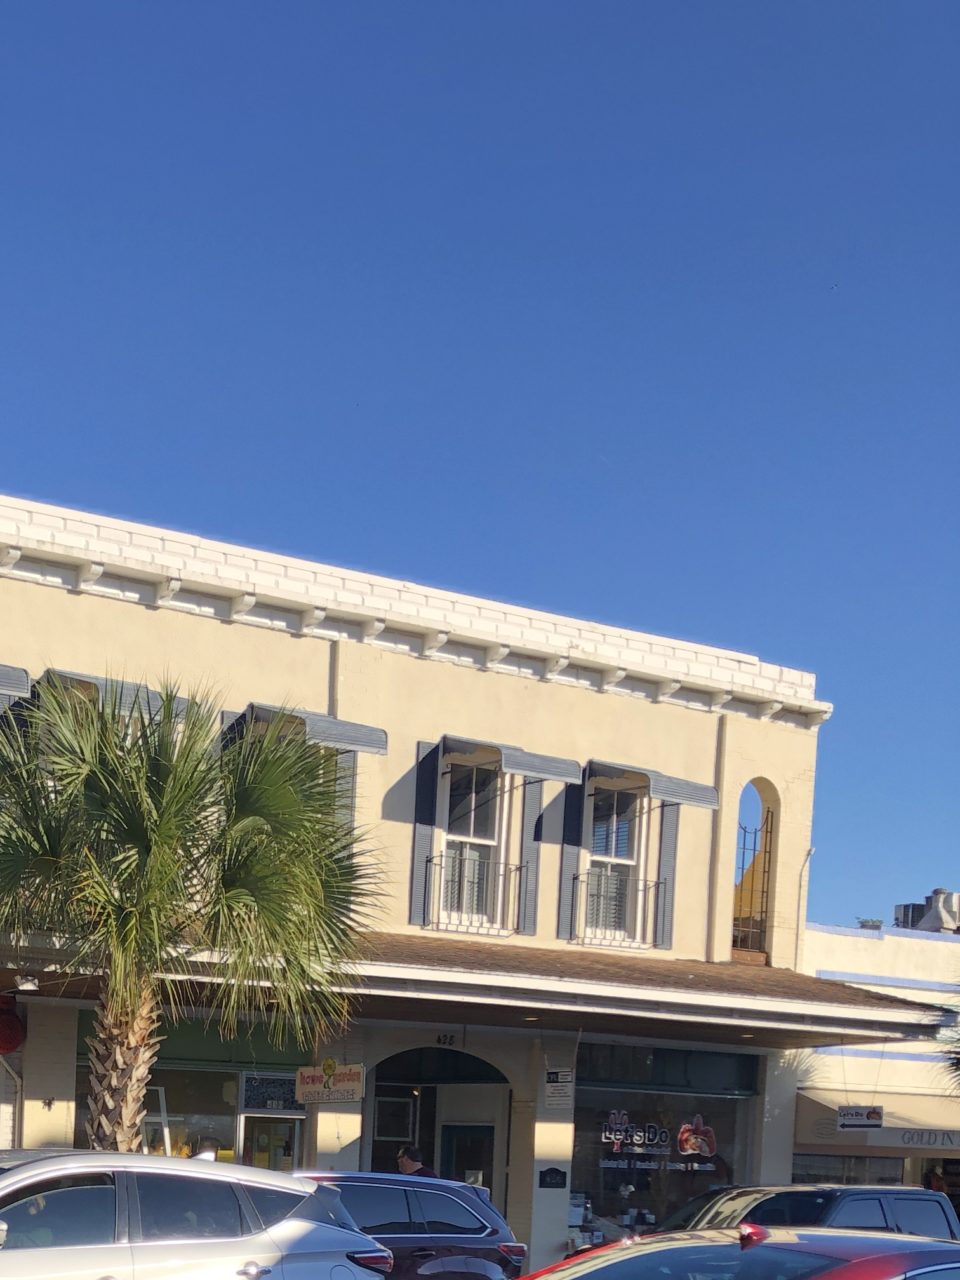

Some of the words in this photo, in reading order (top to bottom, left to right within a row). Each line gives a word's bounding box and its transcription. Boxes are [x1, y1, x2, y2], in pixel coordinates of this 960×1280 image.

[602, 1123, 645, 1144] Let's
[645, 1123, 670, 1145] Do
[901, 1131, 937, 1146] GOLD
[941, 1131, 955, 1146] IN
